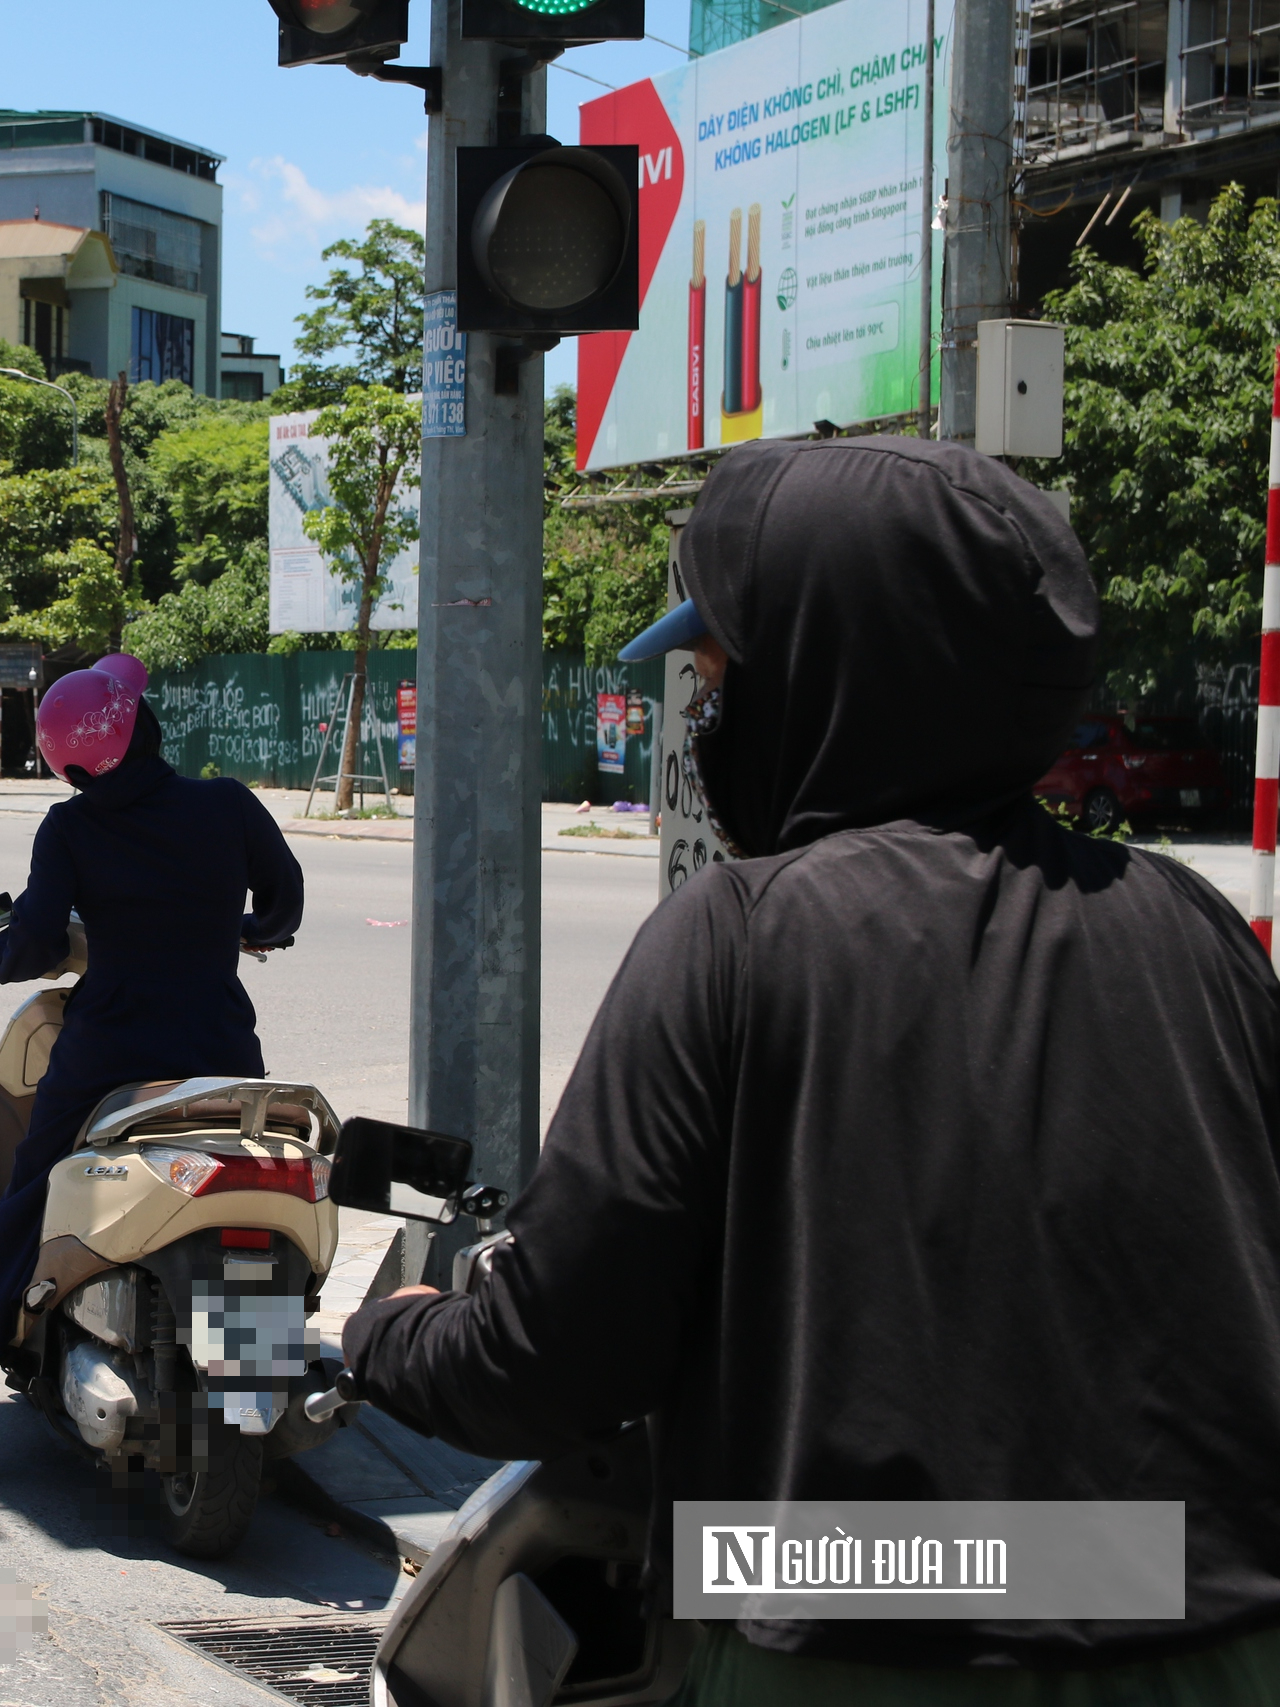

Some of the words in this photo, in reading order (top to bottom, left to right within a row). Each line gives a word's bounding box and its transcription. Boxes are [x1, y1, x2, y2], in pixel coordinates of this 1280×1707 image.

[698, 114, 724, 142] DÂY
[727, 102, 759, 132] ĐIỆN
[763, 83, 813, 120] KHÔNG
[850, 54, 896, 88] CHẬM
[715, 139, 761, 171] KHÔNG
[765, 113, 830, 154] HALOGEN
[861, 105, 871, 123] &
[875, 84, 920, 119] LSHF)
[899, 176, 917, 193] Xanh
[871, 200, 907, 220] Singapore
[692, 344, 700, 417] CADIVI
[442, 402, 464, 424] 138
[84, 1165, 129, 1177] LEAD
